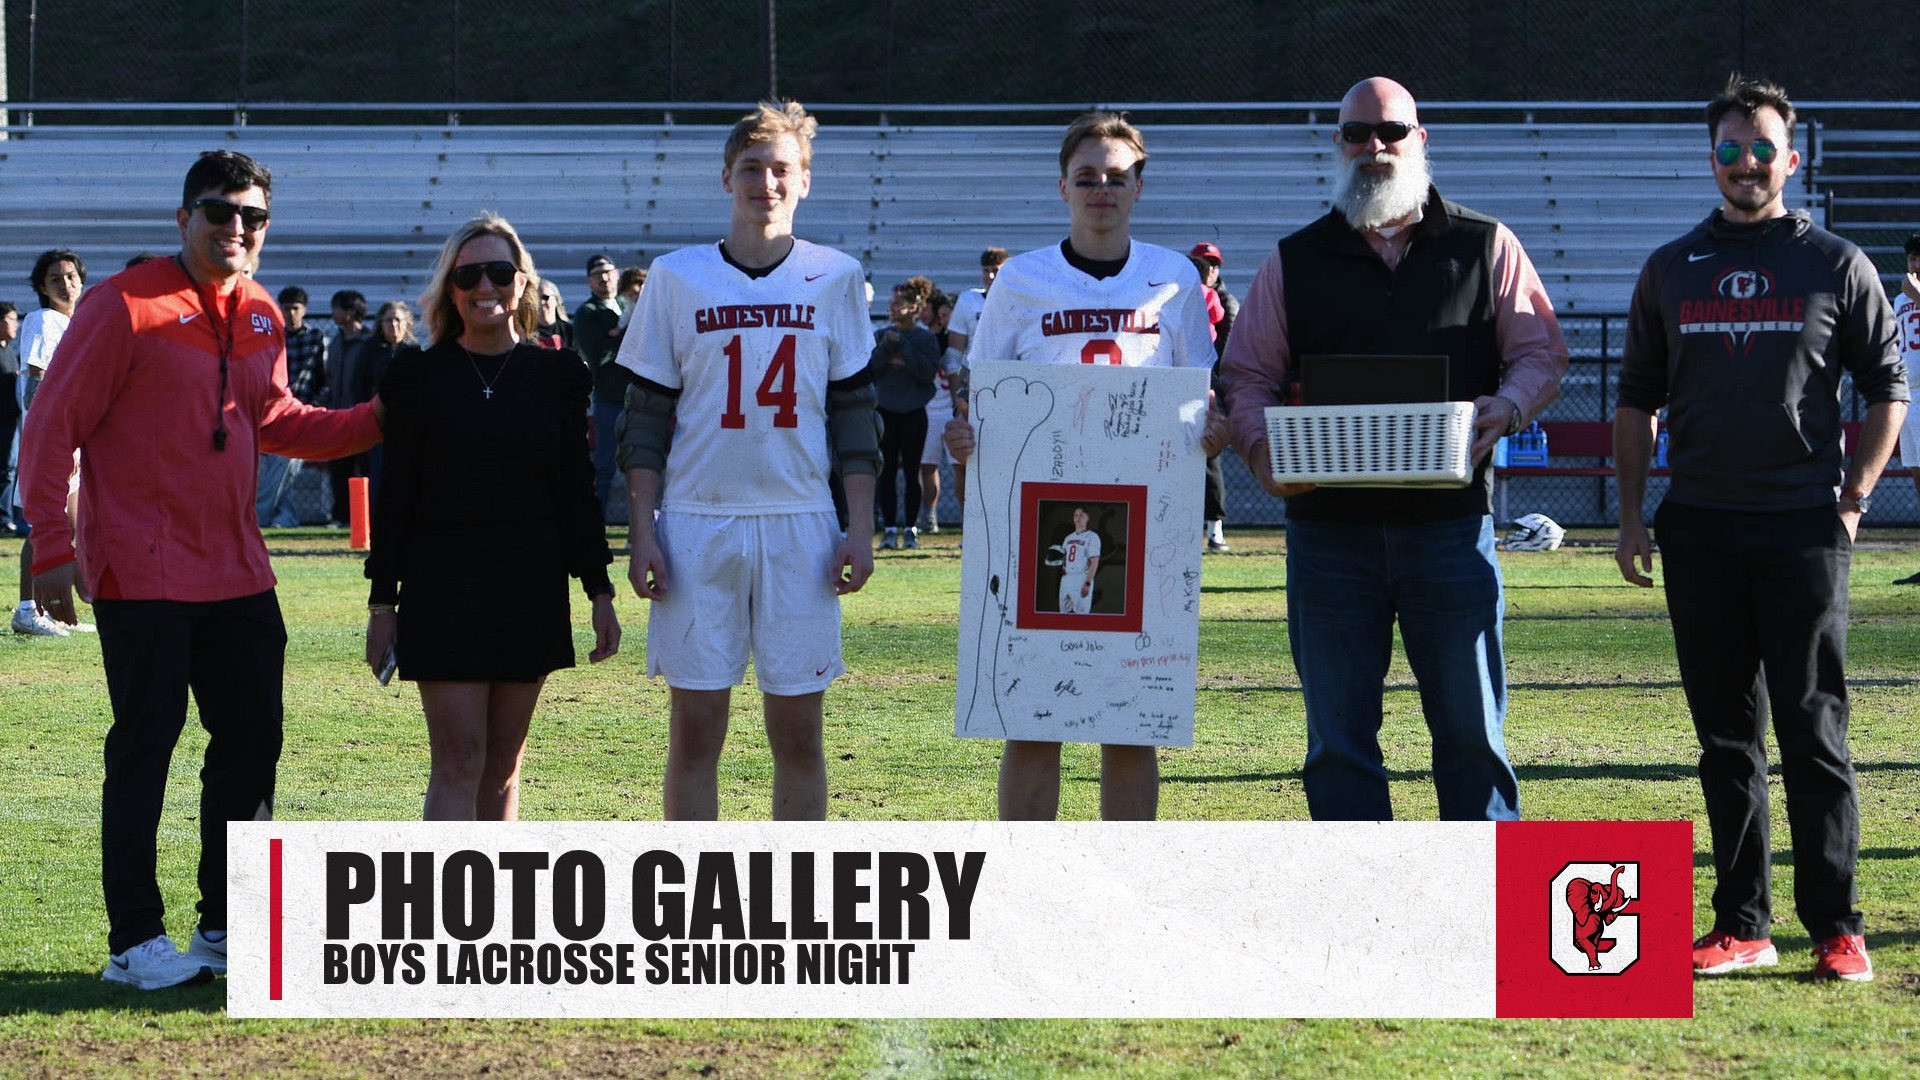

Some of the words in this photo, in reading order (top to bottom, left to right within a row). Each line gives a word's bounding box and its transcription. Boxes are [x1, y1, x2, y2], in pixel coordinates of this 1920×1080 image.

[695, 304, 815, 334] GAINESVILLE
[1041, 309, 1160, 337] GAINESVILLE
[1680, 298, 1805, 323] GAINESVILLE
[1684, 322, 1797, 333] LACROSSE
[721, 334, 797, 429] 14
[1068, 545, 1077, 562] 8
